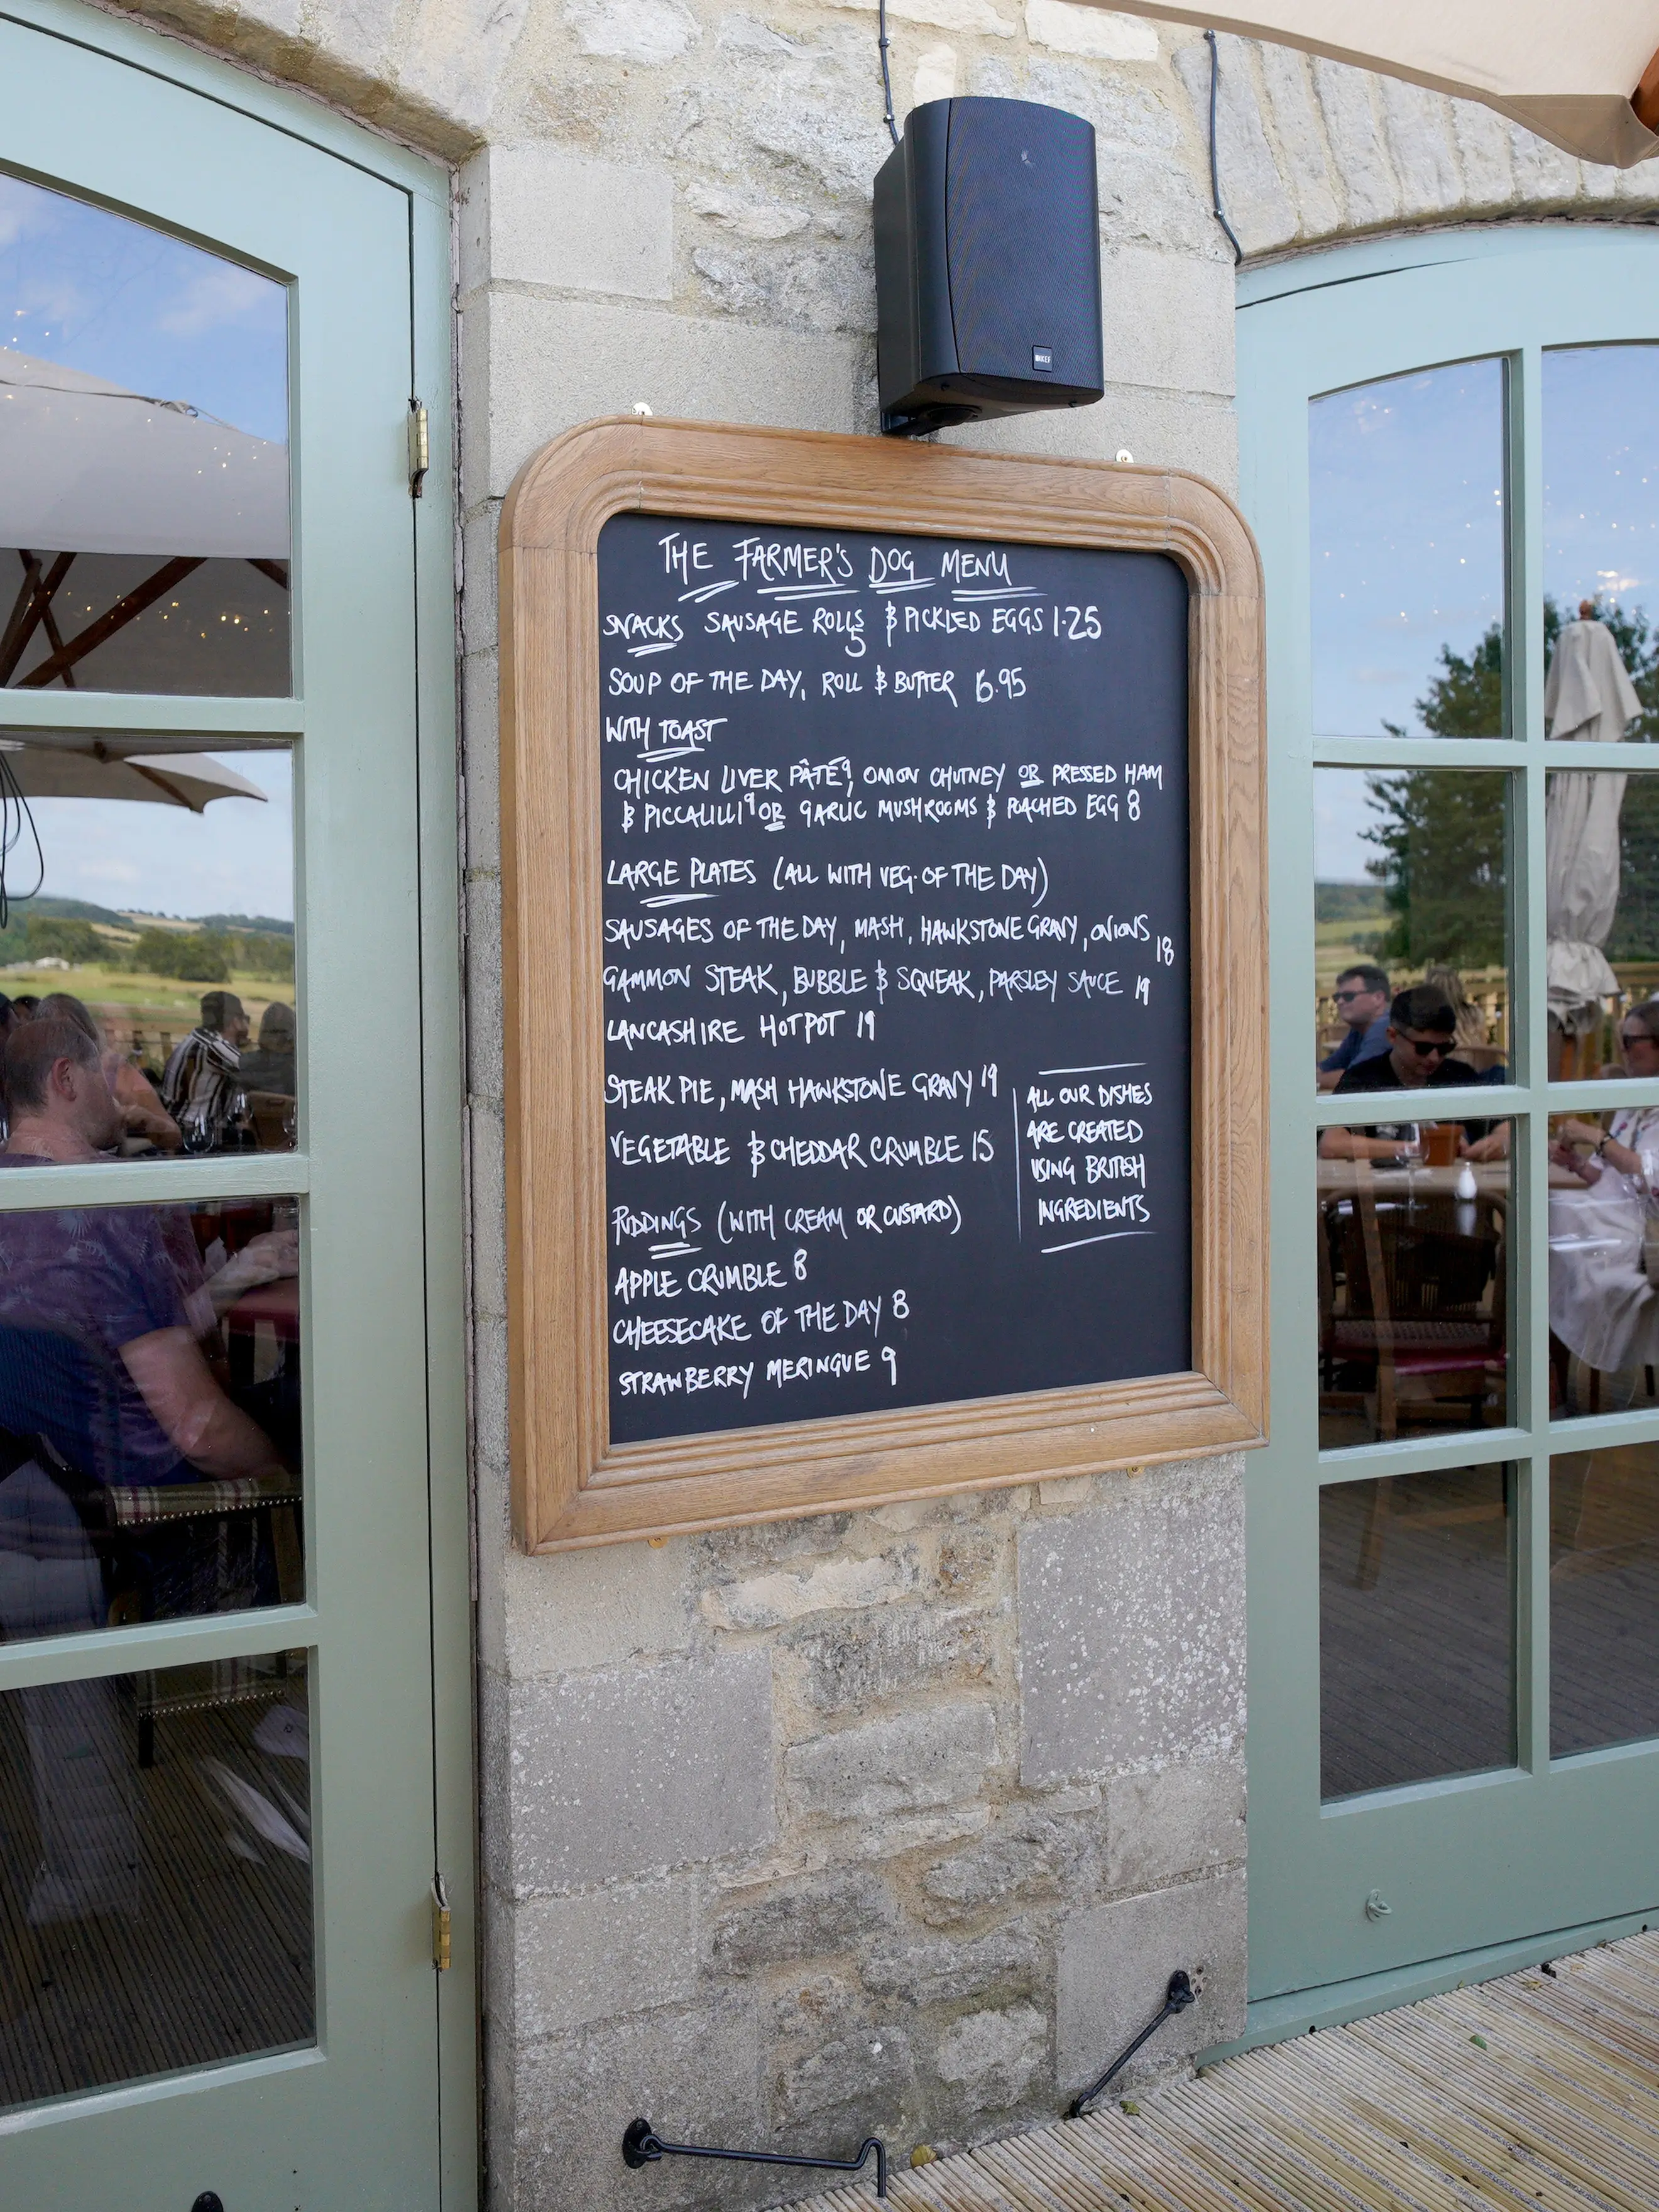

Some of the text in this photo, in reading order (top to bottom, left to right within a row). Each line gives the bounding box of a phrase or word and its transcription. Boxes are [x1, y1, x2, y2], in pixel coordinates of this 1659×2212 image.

[659, 532, 1012, 586] THE FARMER'S DOG MENU
[603, 613, 684, 642] SNACKS
[704, 609, 803, 643] SAUSAGE
[812, 606, 865, 636] ROLLS
[885, 600, 898, 647] &
[904, 605, 981, 634] PICKLED
[992, 607, 1044, 635] EGGS
[1053, 605, 1102, 640] 1.25
[608, 664, 1027, 708] SOUP OF THE DAY, ROLL & BUTTER 6.95
[605, 716, 728, 751] WITH TOAST
[613, 766, 710, 799] CHICKEN
[720, 765, 783, 794] LIVER
[863, 765, 920, 787] ONION
[929, 763, 1006, 793] CHUTNEY
[1018, 764, 1044, 783] OR
[1053, 763, 1117, 787] PRESSED
[1124, 764, 1163, 791] HAM
[621, 788, 1141, 834] & PICCALILLI 9 OR GARLIC MUSHROOMS & POACHED EGG 8
[606, 859, 680, 891] LARGE
[690, 857, 757, 889] PLATES
[772, 855, 819, 891] (ALL
[828, 862, 872, 889] WITH
[921, 865, 949, 889] OF
[951, 862, 996, 892] THE
[1001, 857, 1049, 909] DAY)
[604, 915, 715, 950] SAUSAGES
[723, 917, 752, 941] OF
[756, 915, 799, 942] THE
[802, 915, 845, 955] DAY,
[921, 914, 1024, 946] HAWKSTONE
[1156, 935, 1175, 966] 18
[603, 963, 691, 1003] GAMMON
[704, 963, 788, 1007] STEAK,
[793, 965, 868, 995] BUBBLE
[874, 959, 889, 1005] &
[988, 968, 1058, 1002] PARSLEY
[1067, 969, 1124, 999] SAUCE
[1135, 975, 1151, 1006] 19
[606, 1017, 745, 1051] LANCASHIRE
[857, 1010, 877, 1041] 19
[603, 1073, 675, 1109] STEAK
[730, 1075, 779, 1110] MASH
[788, 1068, 906, 1109] HAWKSTONE
[912, 1070, 973, 1107] GRAVY
[980, 1063, 998, 1098] 19
[1026, 1082, 1154, 1114] ALL OUR DISHES
[610, 1129, 995, 1179] VEGETABLE & CHEDDAR CRUMBLE 15
[1026, 1119, 1144, 1149] ARE CREATED
[1031, 1153, 1146, 1189] USING BRITISH
[611, 1195, 961, 1246] PUDDINGS (WITH CREAM OR CUSTARD)
[1038, 1194, 1151, 1226] INGREDIENTS
[614, 1247, 808, 1305] APPLE CRUMBLE 8
[613, 1289, 909, 1350] CHEESECAKE OF THE DAY 8
[619, 1346, 897, 1400] STRAWBERRY MERINGUE 9
